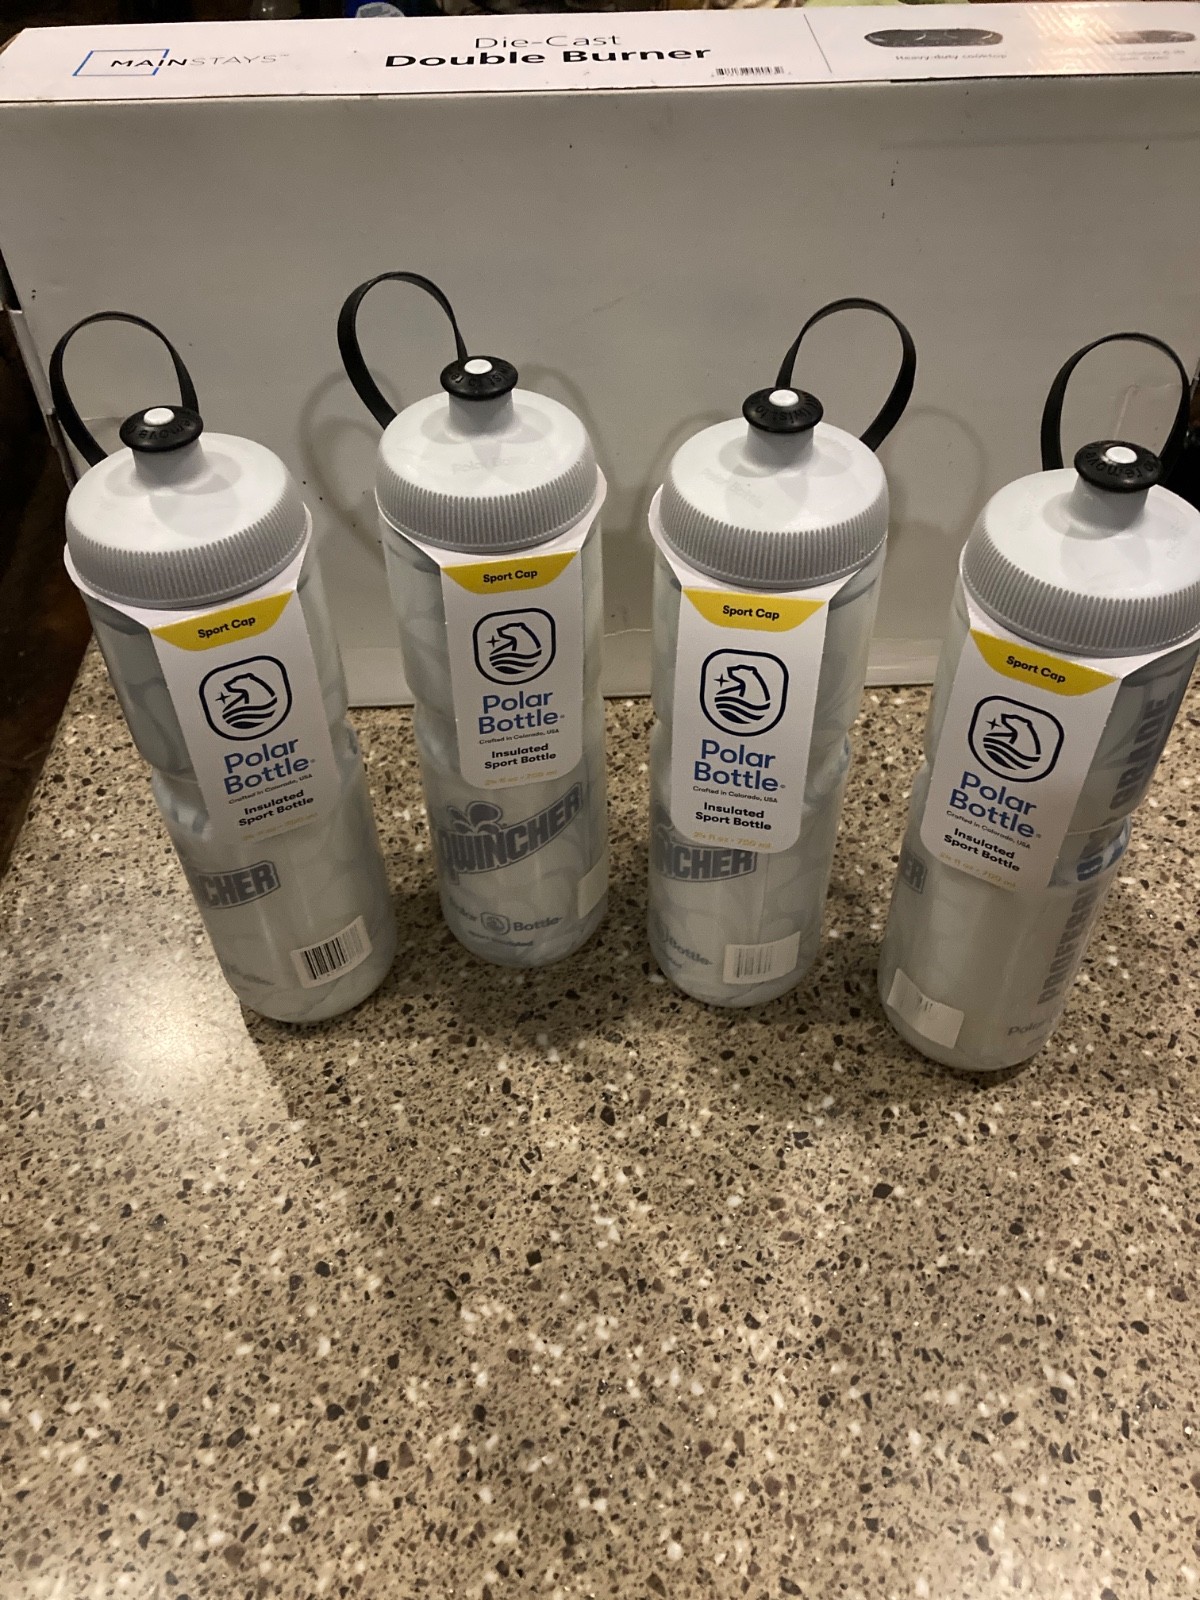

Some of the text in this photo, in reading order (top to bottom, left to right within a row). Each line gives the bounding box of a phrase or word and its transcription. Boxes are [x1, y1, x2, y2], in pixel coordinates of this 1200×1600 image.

[475, 34, 621, 49] Die-Cast
[111, 54, 277, 67] MAINSTAYS
[385, 49, 711, 67] Double Burner
[483, 569, 538, 584] Sport Cap
[722, 605, 780, 621] Sport Cap
[197, 615, 256, 639] Sport Cap
[1006, 655, 1066, 684] Sport Cap
[482, 690, 553, 714] Polar
[478, 710, 559, 735] Bottle
[224, 738, 298, 774] Polar
[484, 751, 556, 770] Sport Bottle
[491, 743, 549, 759] Insulated
[701, 739, 776, 769] Polar
[224, 757, 309, 795] Bottle
[694, 760, 778, 792] Bottle
[244, 790, 304, 815] Insulated
[960, 771, 1037, 816] Polar
[238, 809, 275, 827] Sport
[276, 797, 314, 813] Bottle
[695, 812, 772, 831] Sport Bottle
[703, 801, 765, 819] Insulated
[950, 788, 1035, 839] Bottle
[437, 785, 580, 884] QWINCHER
[954, 827, 1015, 860] Insulated
[944, 834, 1020, 873] Sport Bottle
